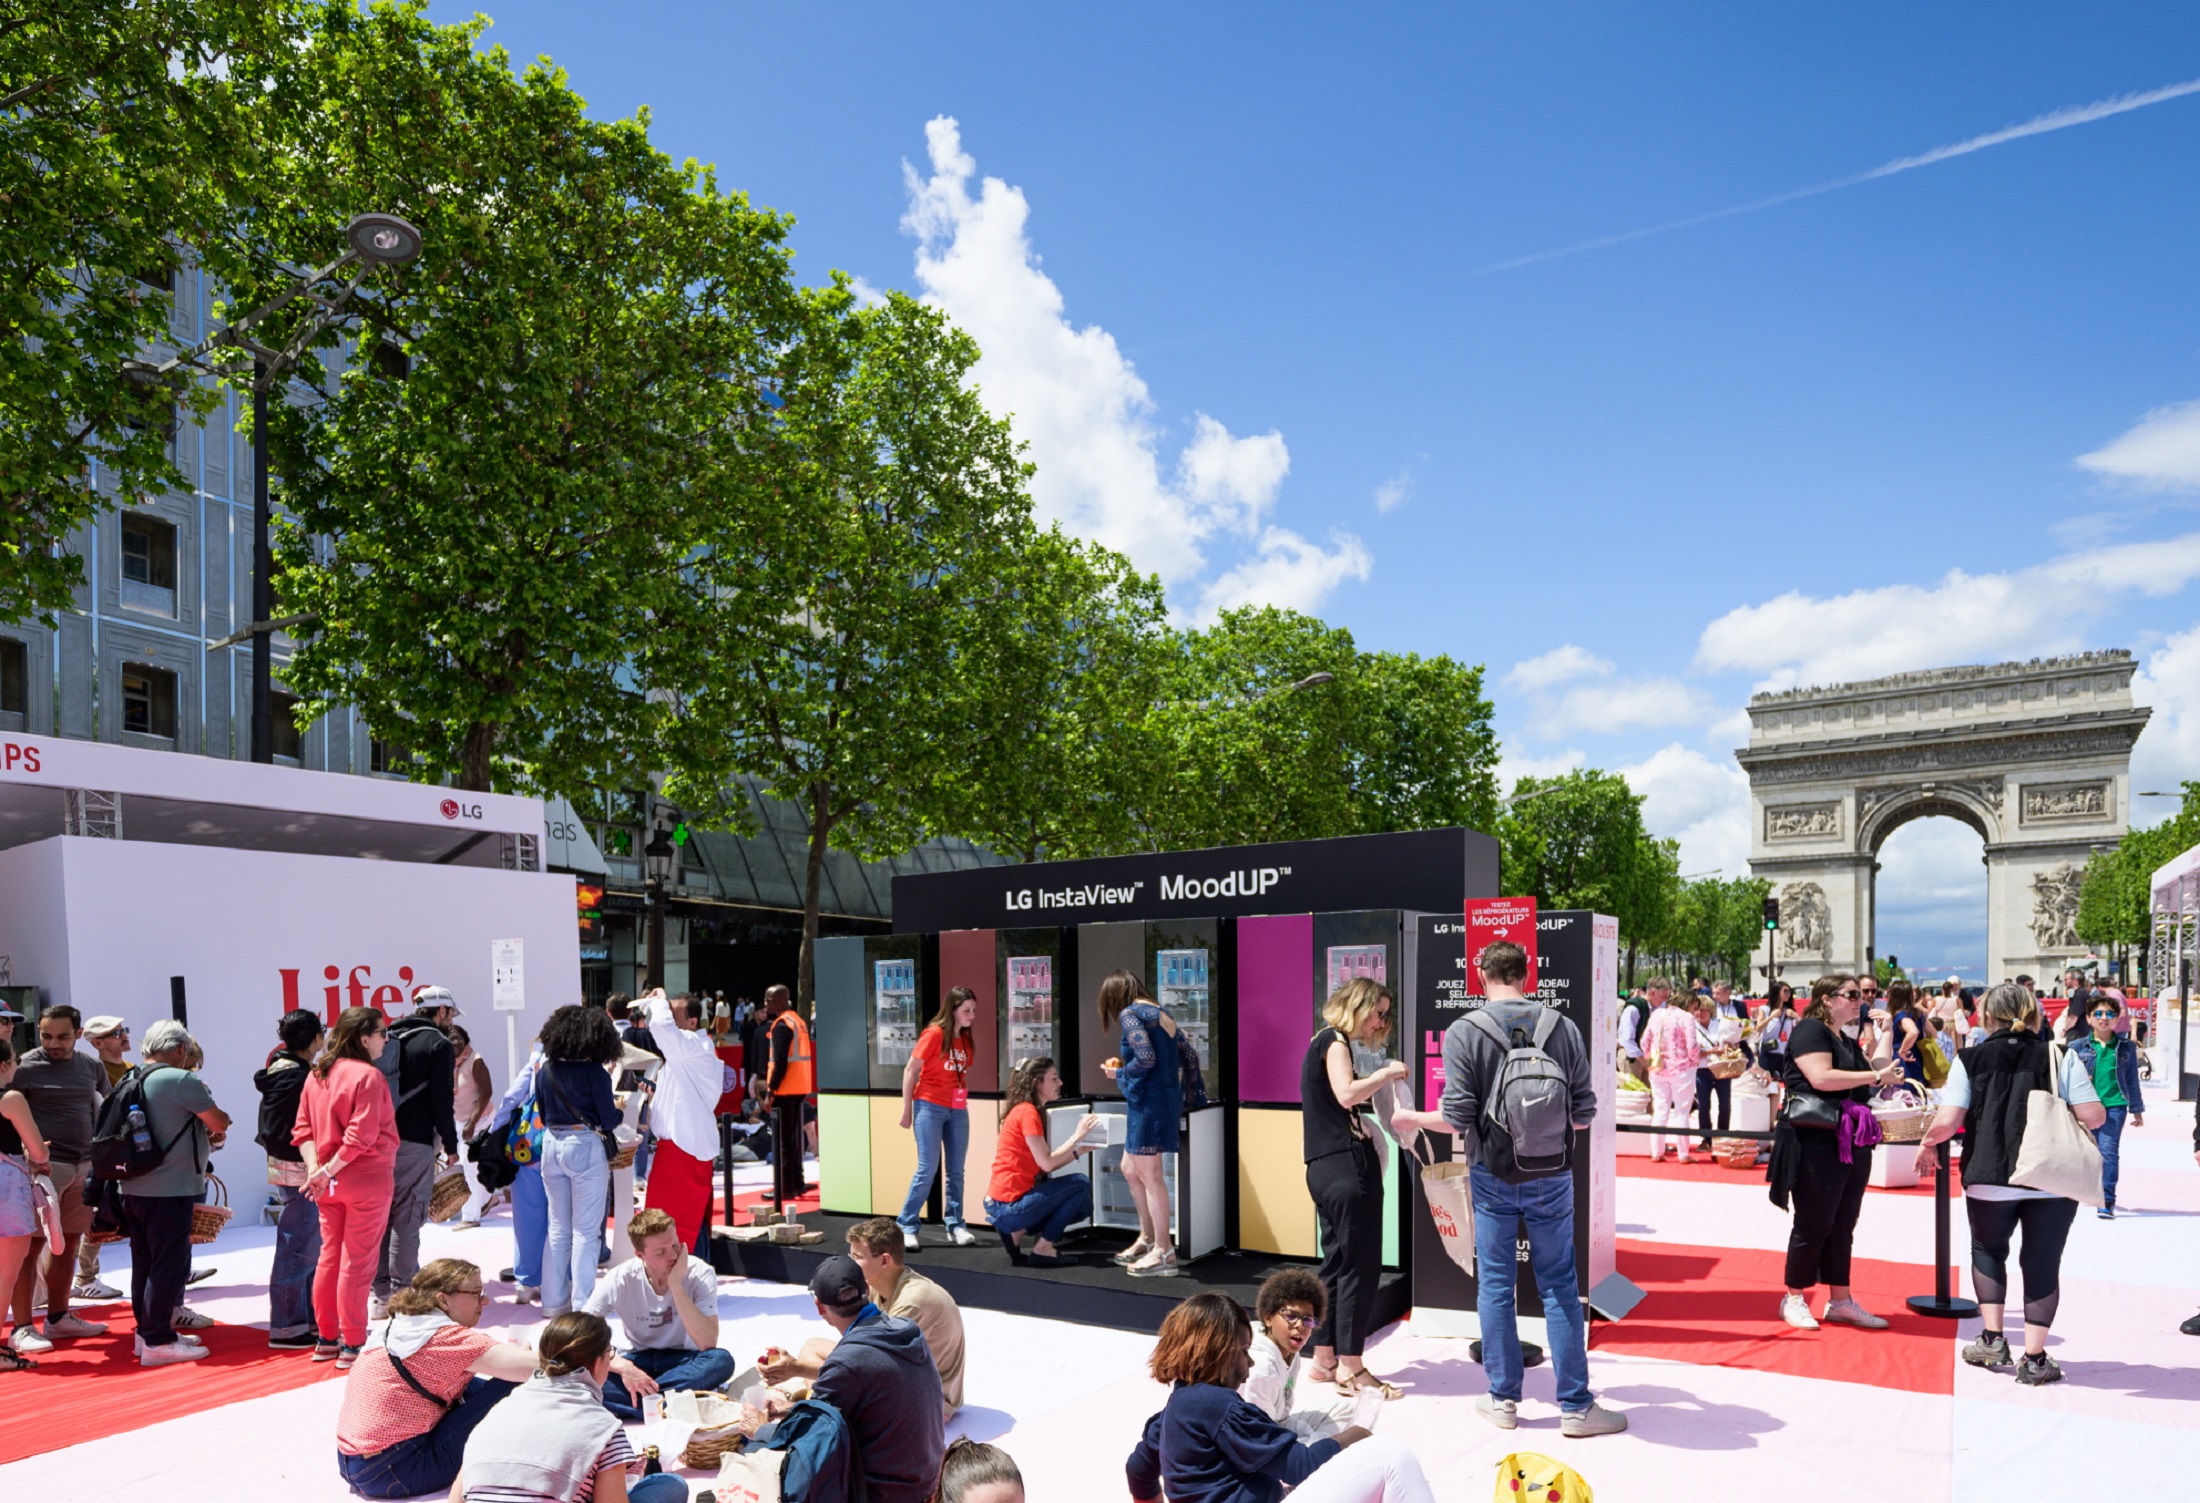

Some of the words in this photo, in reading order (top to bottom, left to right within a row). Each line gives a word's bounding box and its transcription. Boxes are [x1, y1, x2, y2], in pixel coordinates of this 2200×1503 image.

[0, 743, 41, 773] PS
[462, 804, 482, 819] LG
[1006, 889, 1032, 910] LG
[1160, 866, 1291, 900] MoodUP™
[1434, 924, 1448, 933] LG
[1436, 980, 1464, 989] JOUEZ
[1537, 989, 1556, 998] DES
[1435, 1000, 1442, 1009] 3
